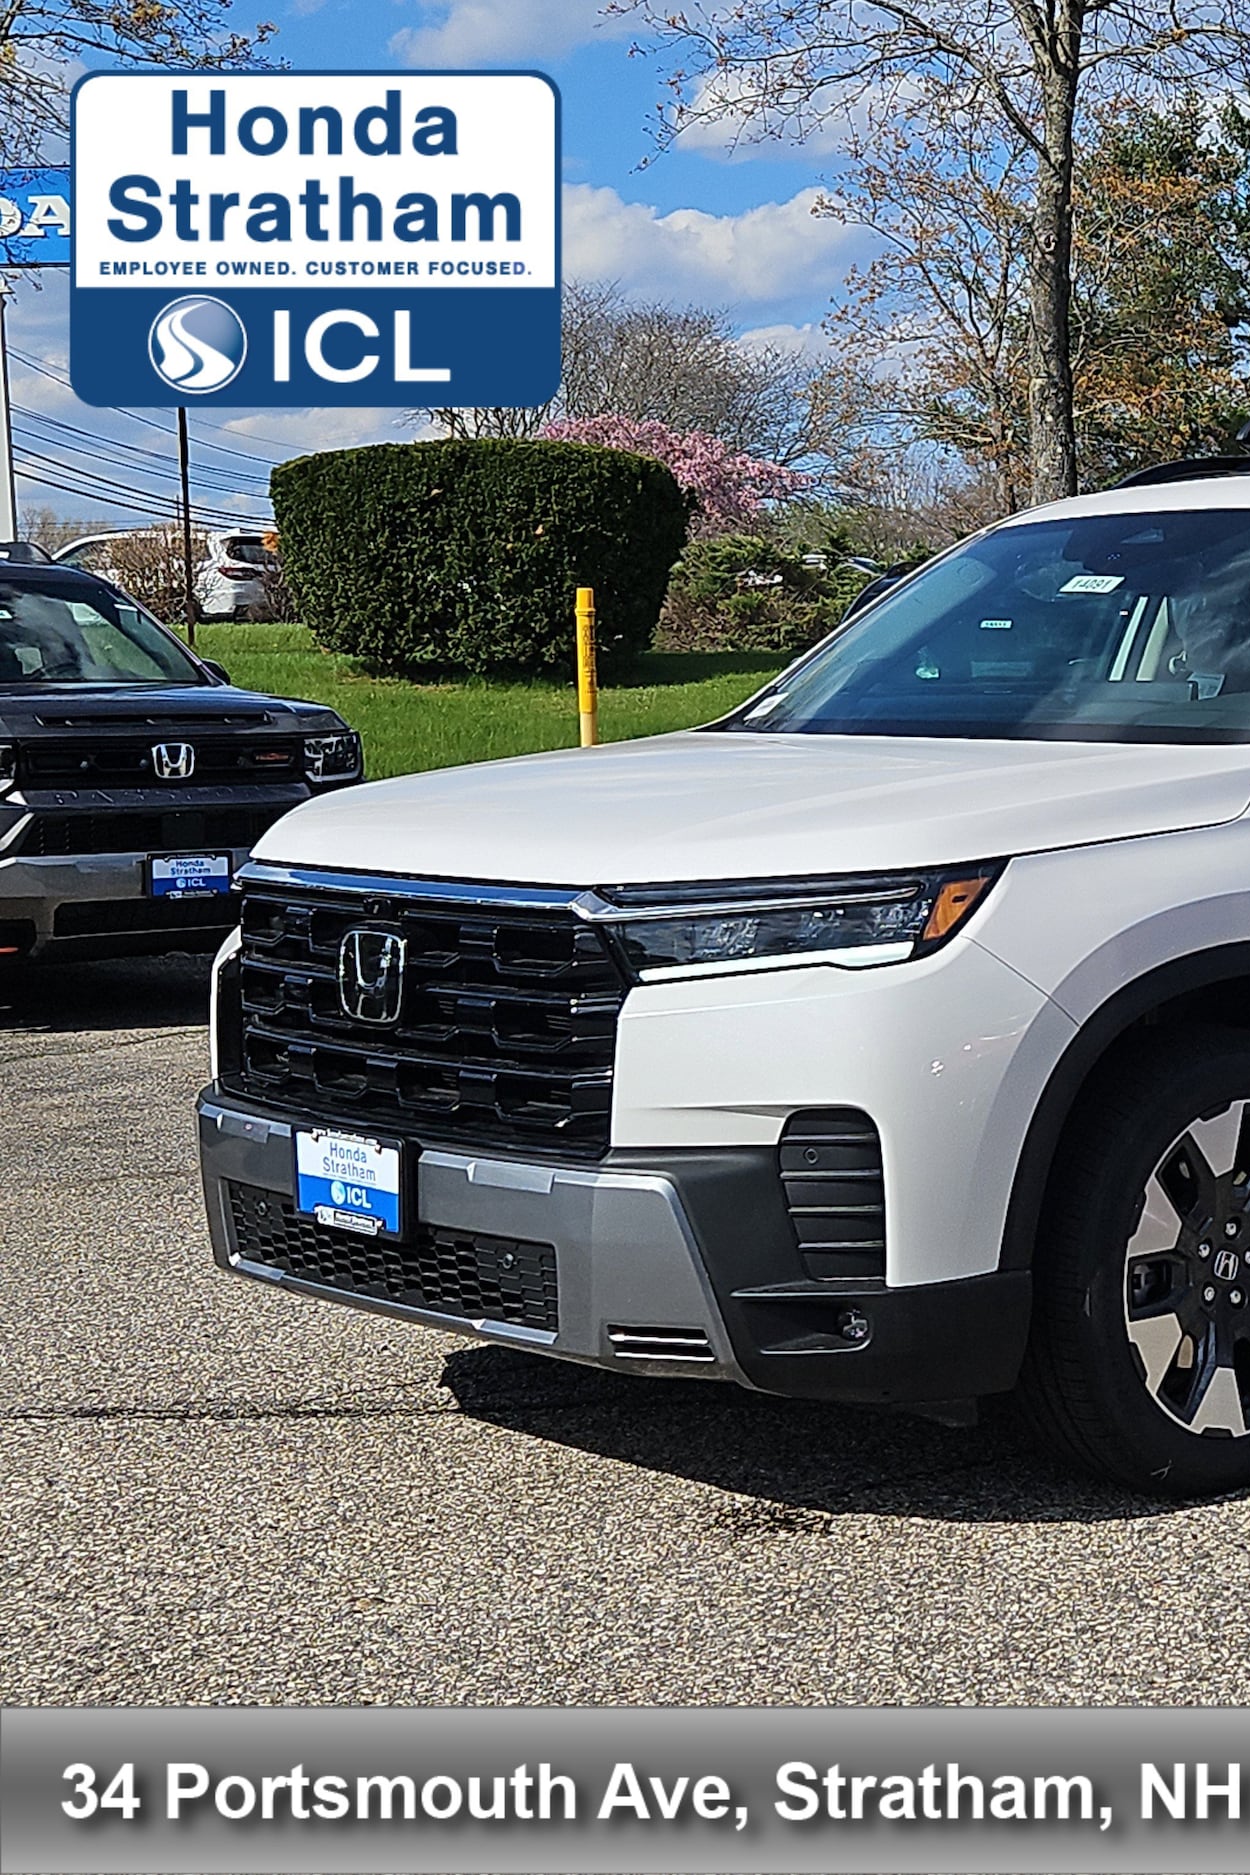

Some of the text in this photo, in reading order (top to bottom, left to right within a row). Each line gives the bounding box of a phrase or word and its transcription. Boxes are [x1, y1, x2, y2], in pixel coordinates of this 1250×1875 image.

[170, 867, 211, 876] Stratham
[175, 860, 205, 868] Honda
[187, 878, 207, 888] ICL
[329, 1142, 367, 1164] Honda
[322, 1157, 376, 1182] Stratham
[346, 1186, 373, 1209] ICL
